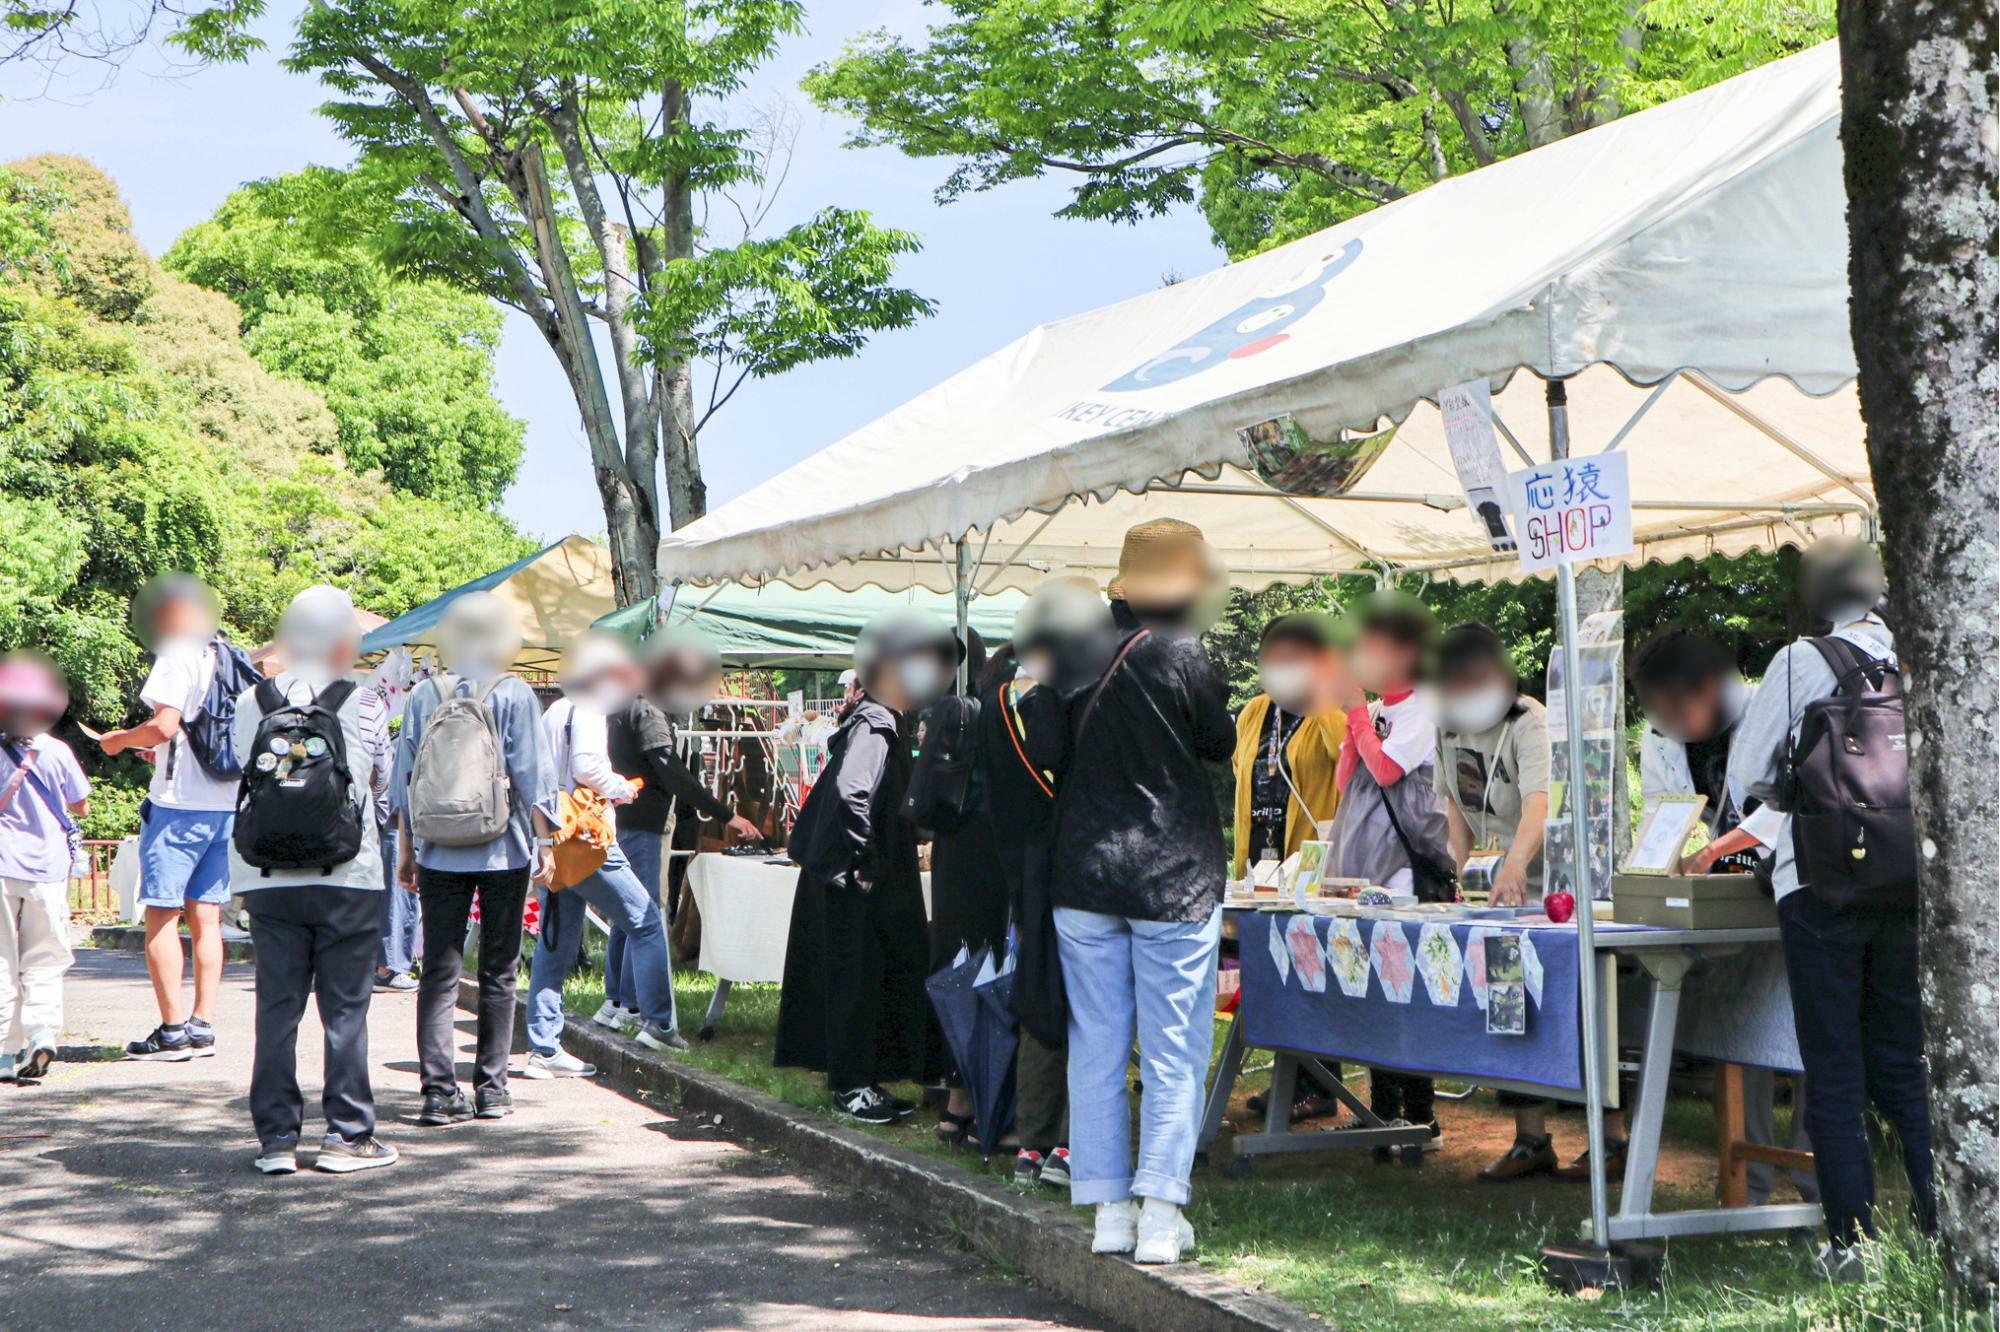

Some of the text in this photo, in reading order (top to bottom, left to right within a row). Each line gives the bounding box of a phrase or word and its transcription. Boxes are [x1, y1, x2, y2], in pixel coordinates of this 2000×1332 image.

[1057, 401, 1118, 423] KEY
[1525, 462, 1610, 511] 応猿
[1528, 504, 1612, 560] SHOP
